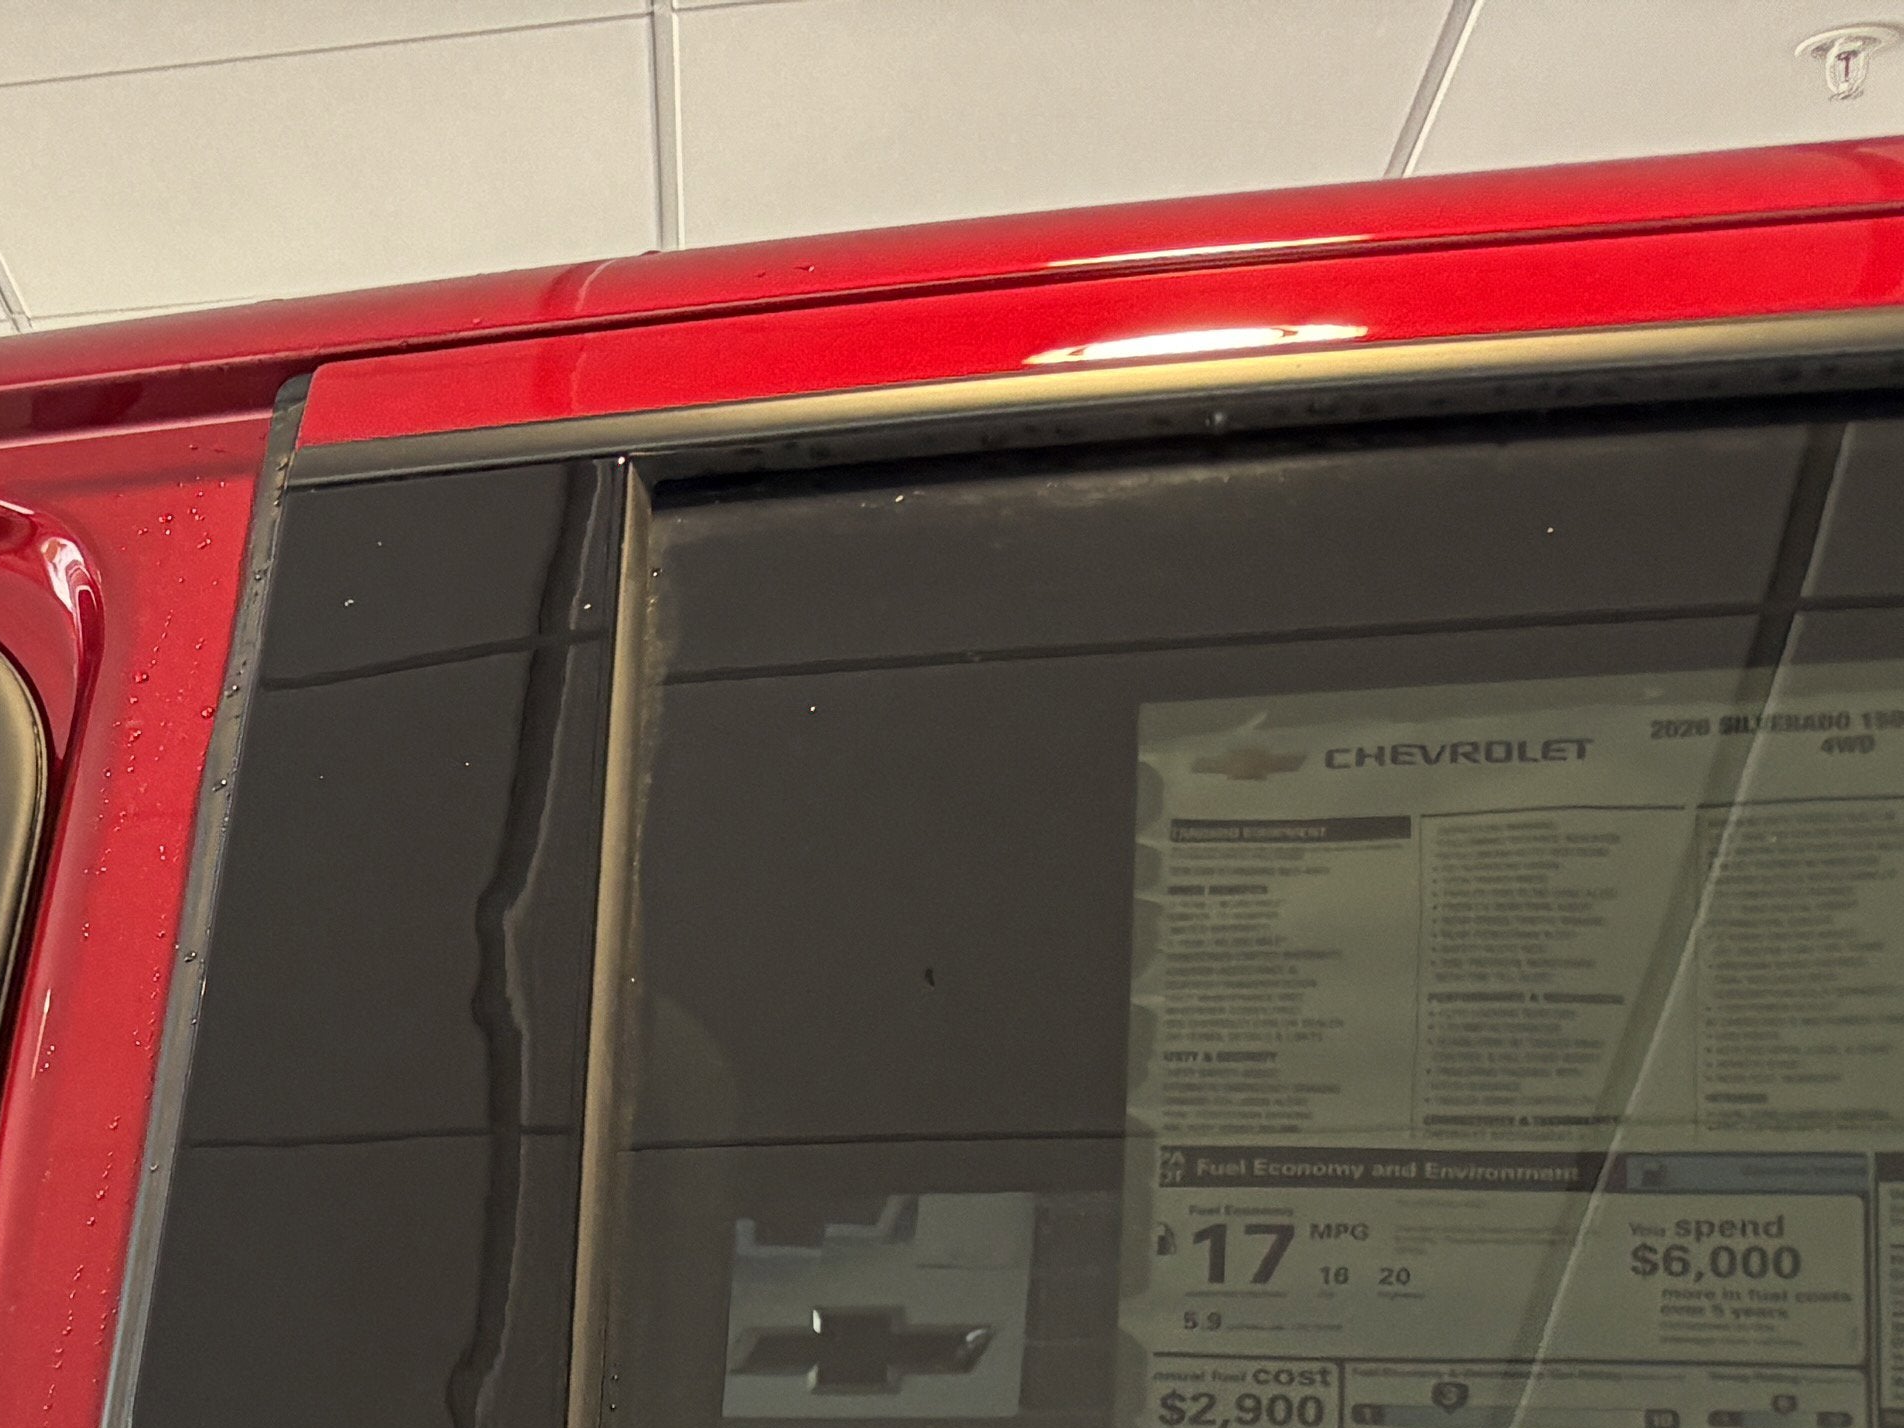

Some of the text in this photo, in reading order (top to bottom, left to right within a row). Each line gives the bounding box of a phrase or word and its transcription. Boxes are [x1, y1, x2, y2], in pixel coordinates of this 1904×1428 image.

[1324, 737, 1594, 770] CHEVROLET
[1197, 1157, 1579, 1183] Fuel Economy and Environment
[1310, 1222, 1370, 1242] MPG
[1674, 1214, 1785, 1242] spend
[1192, 1222, 1296, 1285] 17
[1629, 1243, 1802, 1282] $6,000
[1378, 1266, 1411, 1286] 20
[1252, 1365, 1332, 1388] cost
